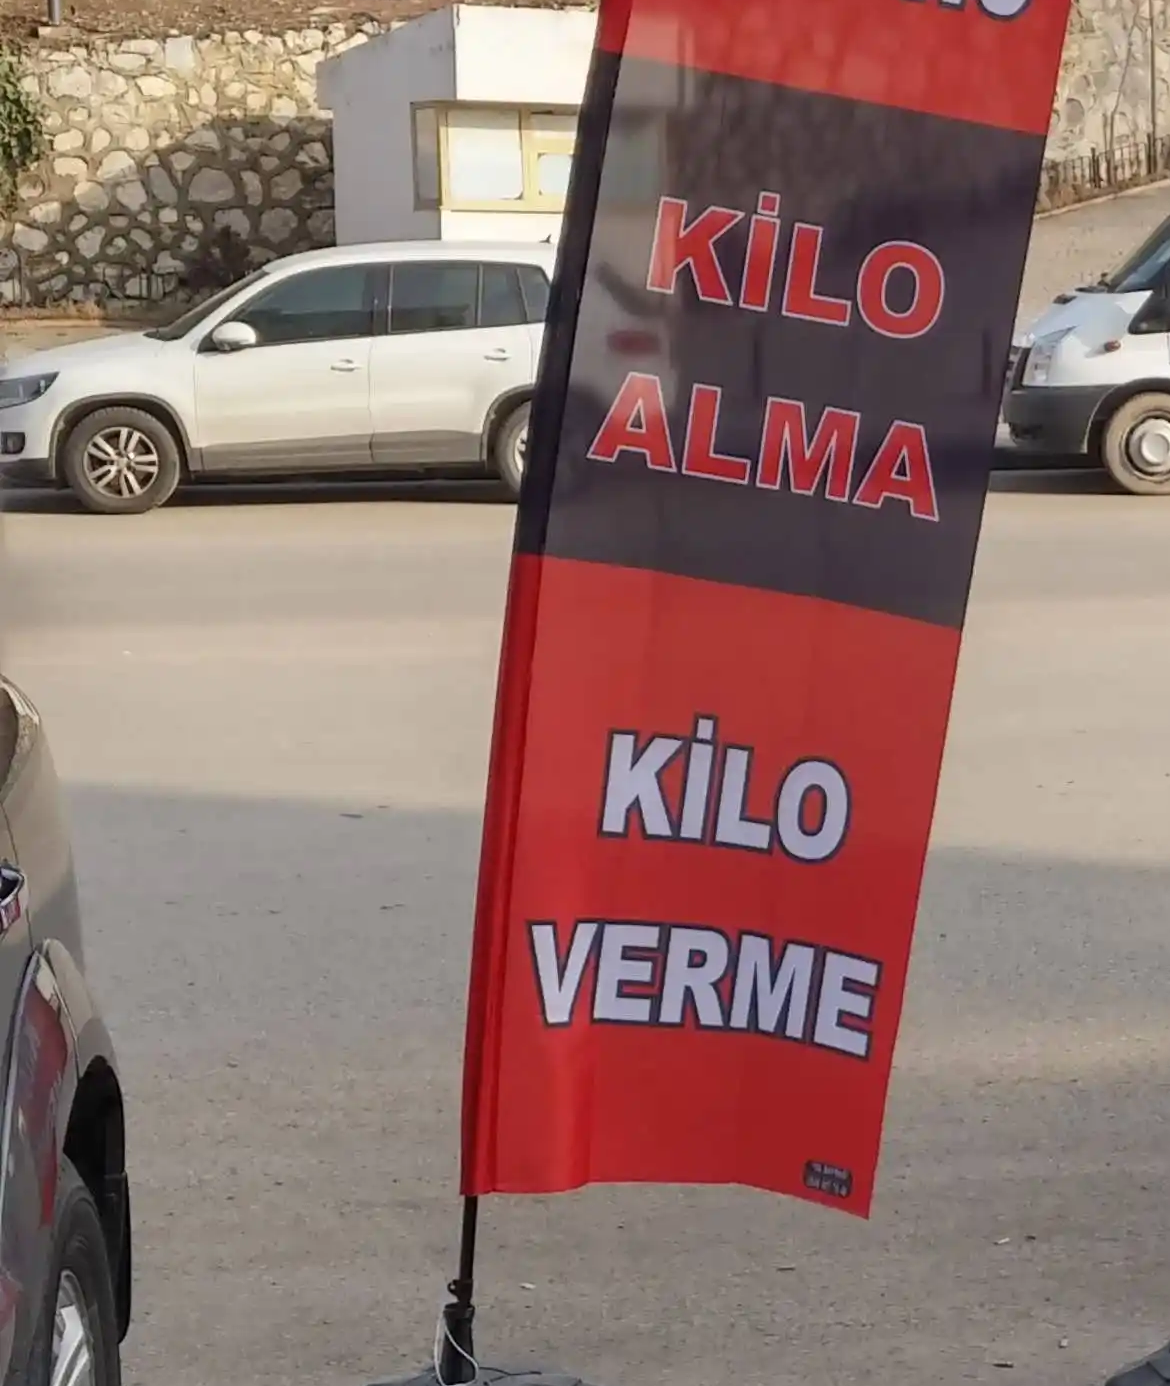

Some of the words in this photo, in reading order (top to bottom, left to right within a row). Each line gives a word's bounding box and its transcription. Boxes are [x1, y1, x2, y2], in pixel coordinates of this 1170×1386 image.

[646, 190, 946, 340] KİLO
[587, 371, 941, 523] ALMA
[597, 714, 852, 865] KİLO
[525, 918, 883, 1060] VERME
